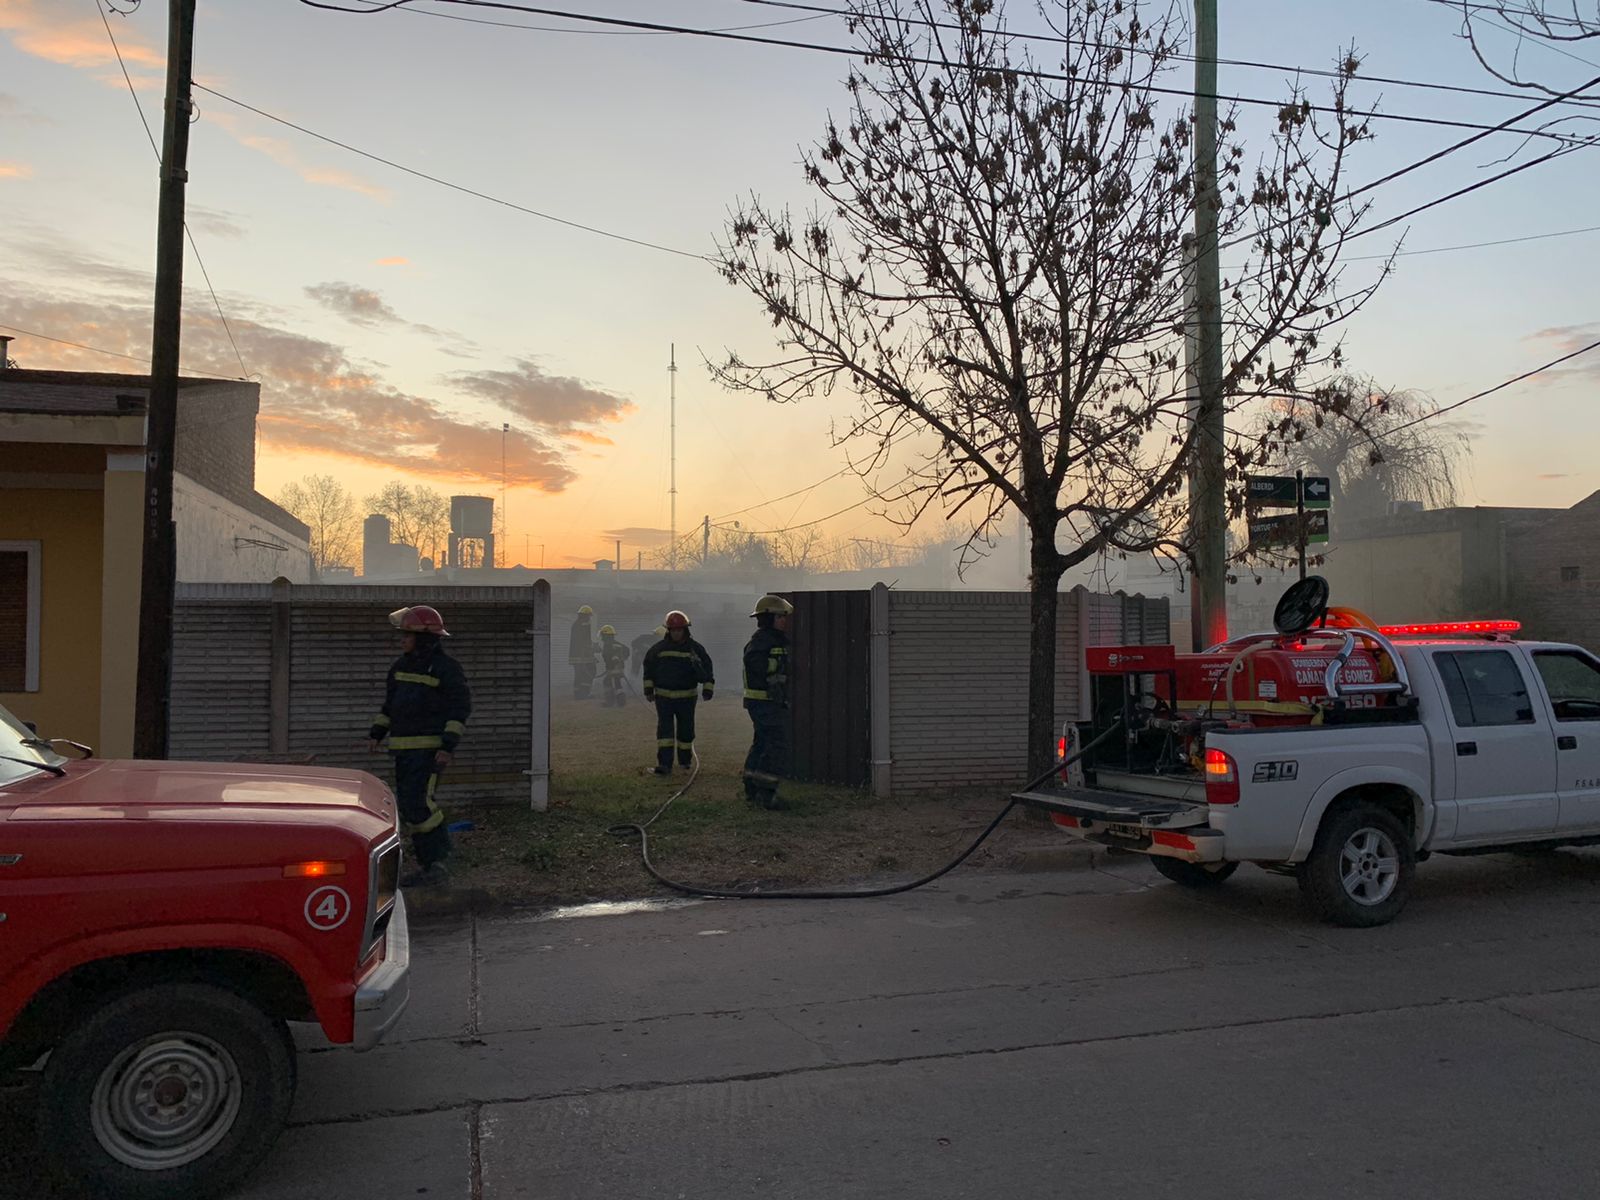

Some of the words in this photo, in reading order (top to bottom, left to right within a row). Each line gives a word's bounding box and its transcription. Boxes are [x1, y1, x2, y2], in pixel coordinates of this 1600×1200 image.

[1251, 481, 1275, 491] ALBERDI
[1291, 659, 1327, 668] BOMBEROS
[1296, 667, 1323, 684] CAÑAD
[1345, 670, 1374, 684] GOMEZ
[315, 894, 339, 920] 4
